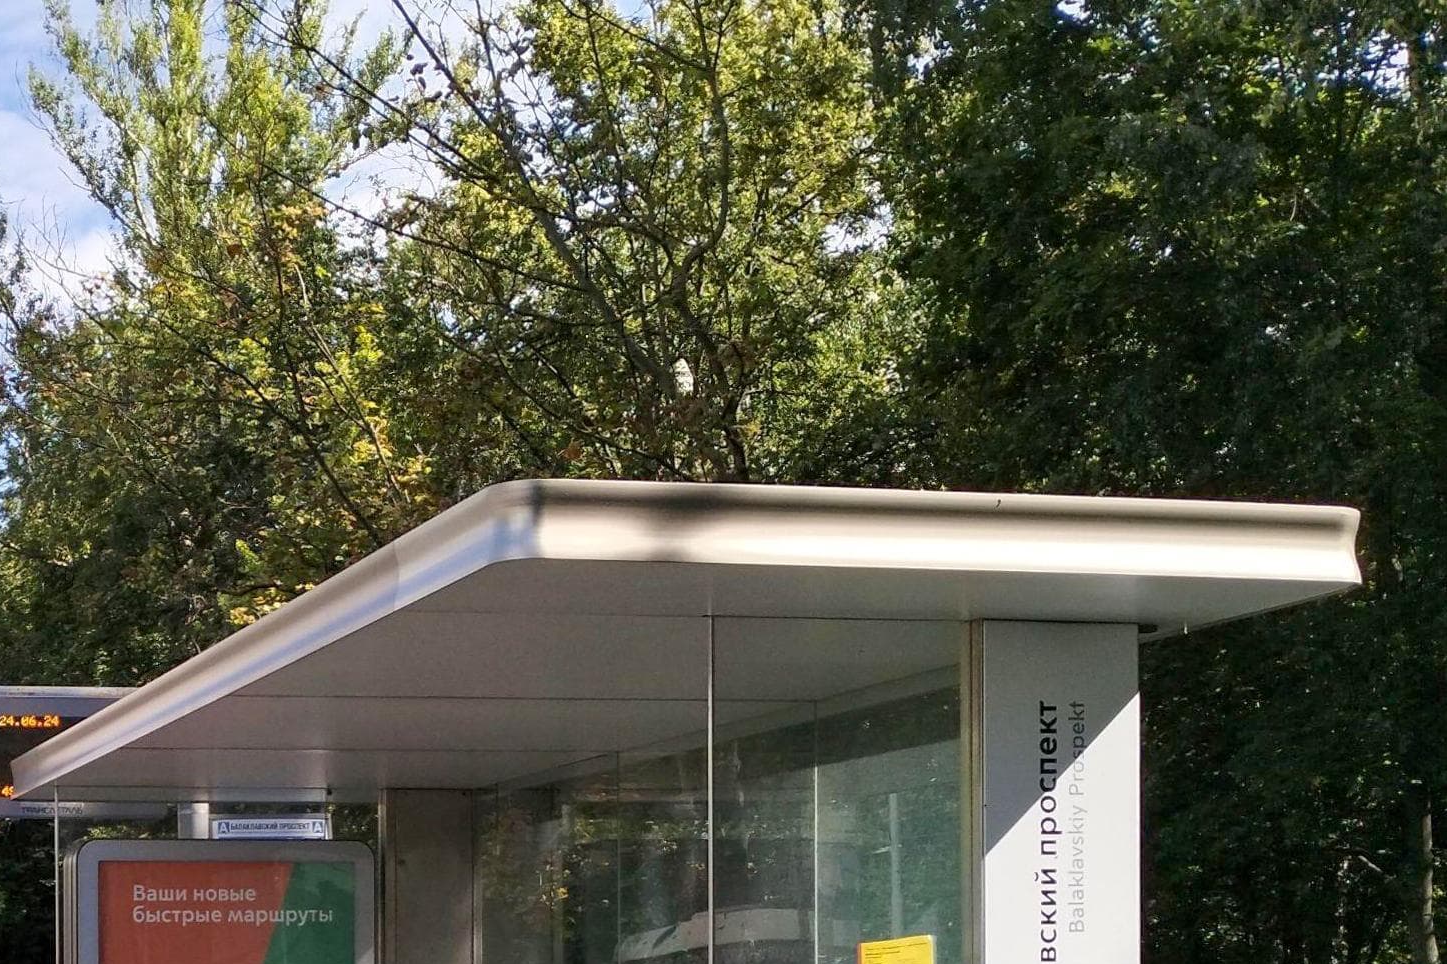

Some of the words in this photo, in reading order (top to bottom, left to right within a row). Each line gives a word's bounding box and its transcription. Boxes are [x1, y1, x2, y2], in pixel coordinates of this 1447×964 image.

[0, 715, 60, 727] 24.06.24
[1068, 700, 1088, 796] Prospekt
[1039, 700, 1062, 856] проспект
[132, 884, 186, 901] Ваши
[193, 887, 256, 901] новые
[1068, 805, 1088, 933] Balaklavskiy
[132, 906, 222, 926] быстрые
[228, 908, 333, 926] маршруты
